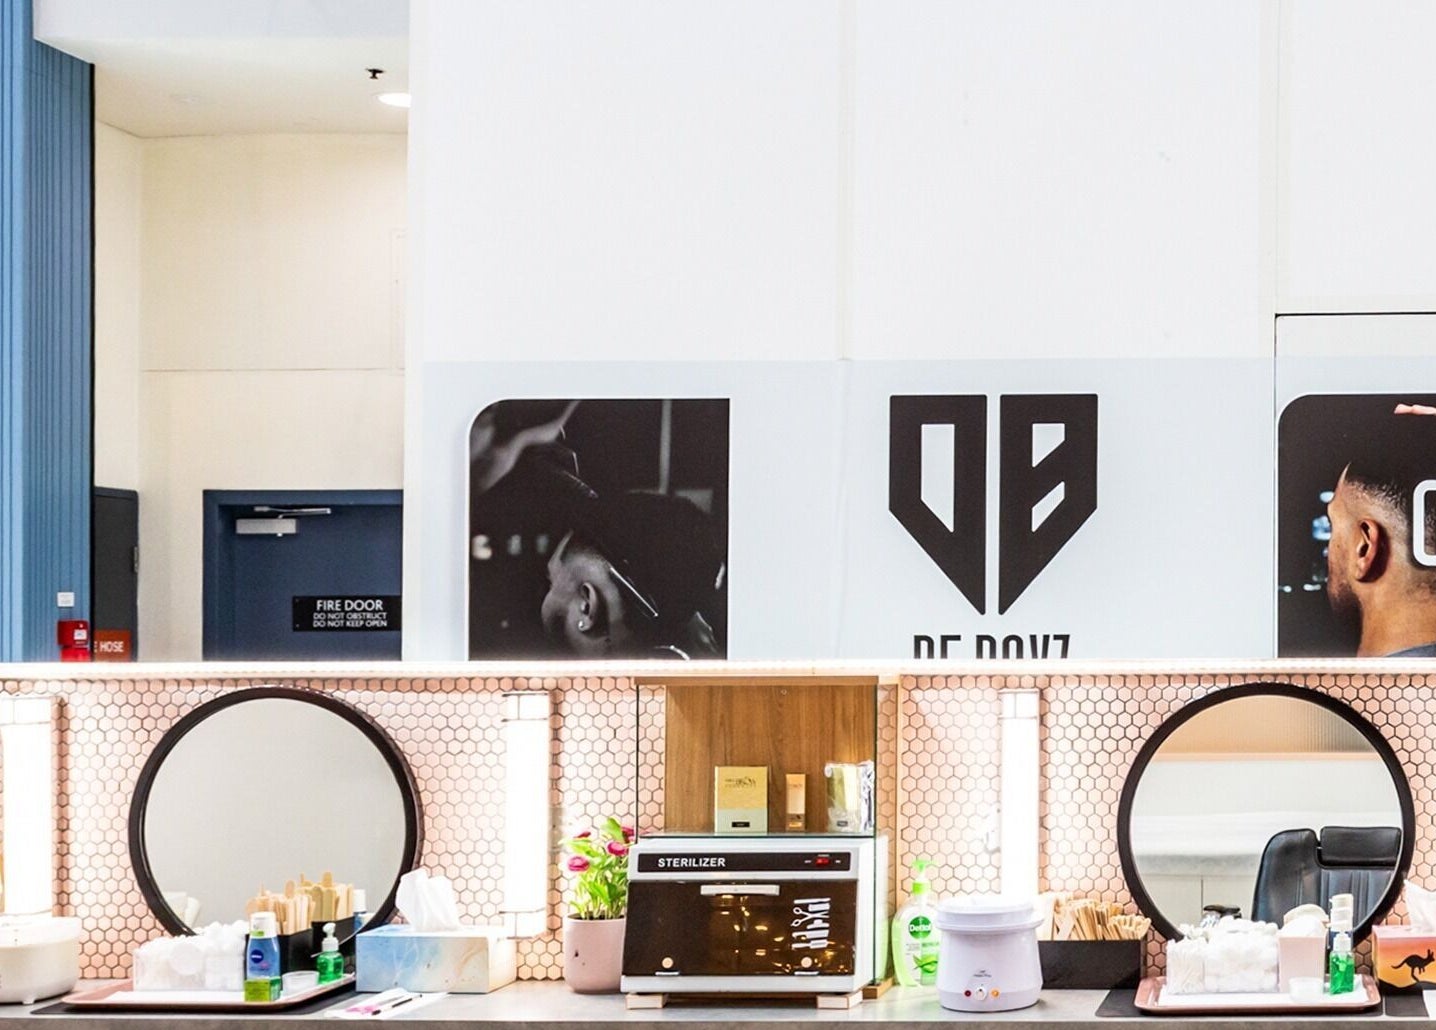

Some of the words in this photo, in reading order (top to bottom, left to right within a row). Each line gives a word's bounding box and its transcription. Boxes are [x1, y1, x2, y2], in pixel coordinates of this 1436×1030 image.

[316, 599, 341, 611] FIRE
[344, 599, 383, 611] DOOR
[312, 612, 326, 620] DO
[327, 612, 344, 620] NOT
[346, 612, 387, 620] OBSTRUCT
[312, 620, 326, 628] DO
[327, 620, 344, 628] NOT
[346, 620, 364, 628] KEEP
[365, 620, 387, 628] OPEN
[100, 641, 124, 652] HOSE
[657, 857, 726, 868] STERILIZER
